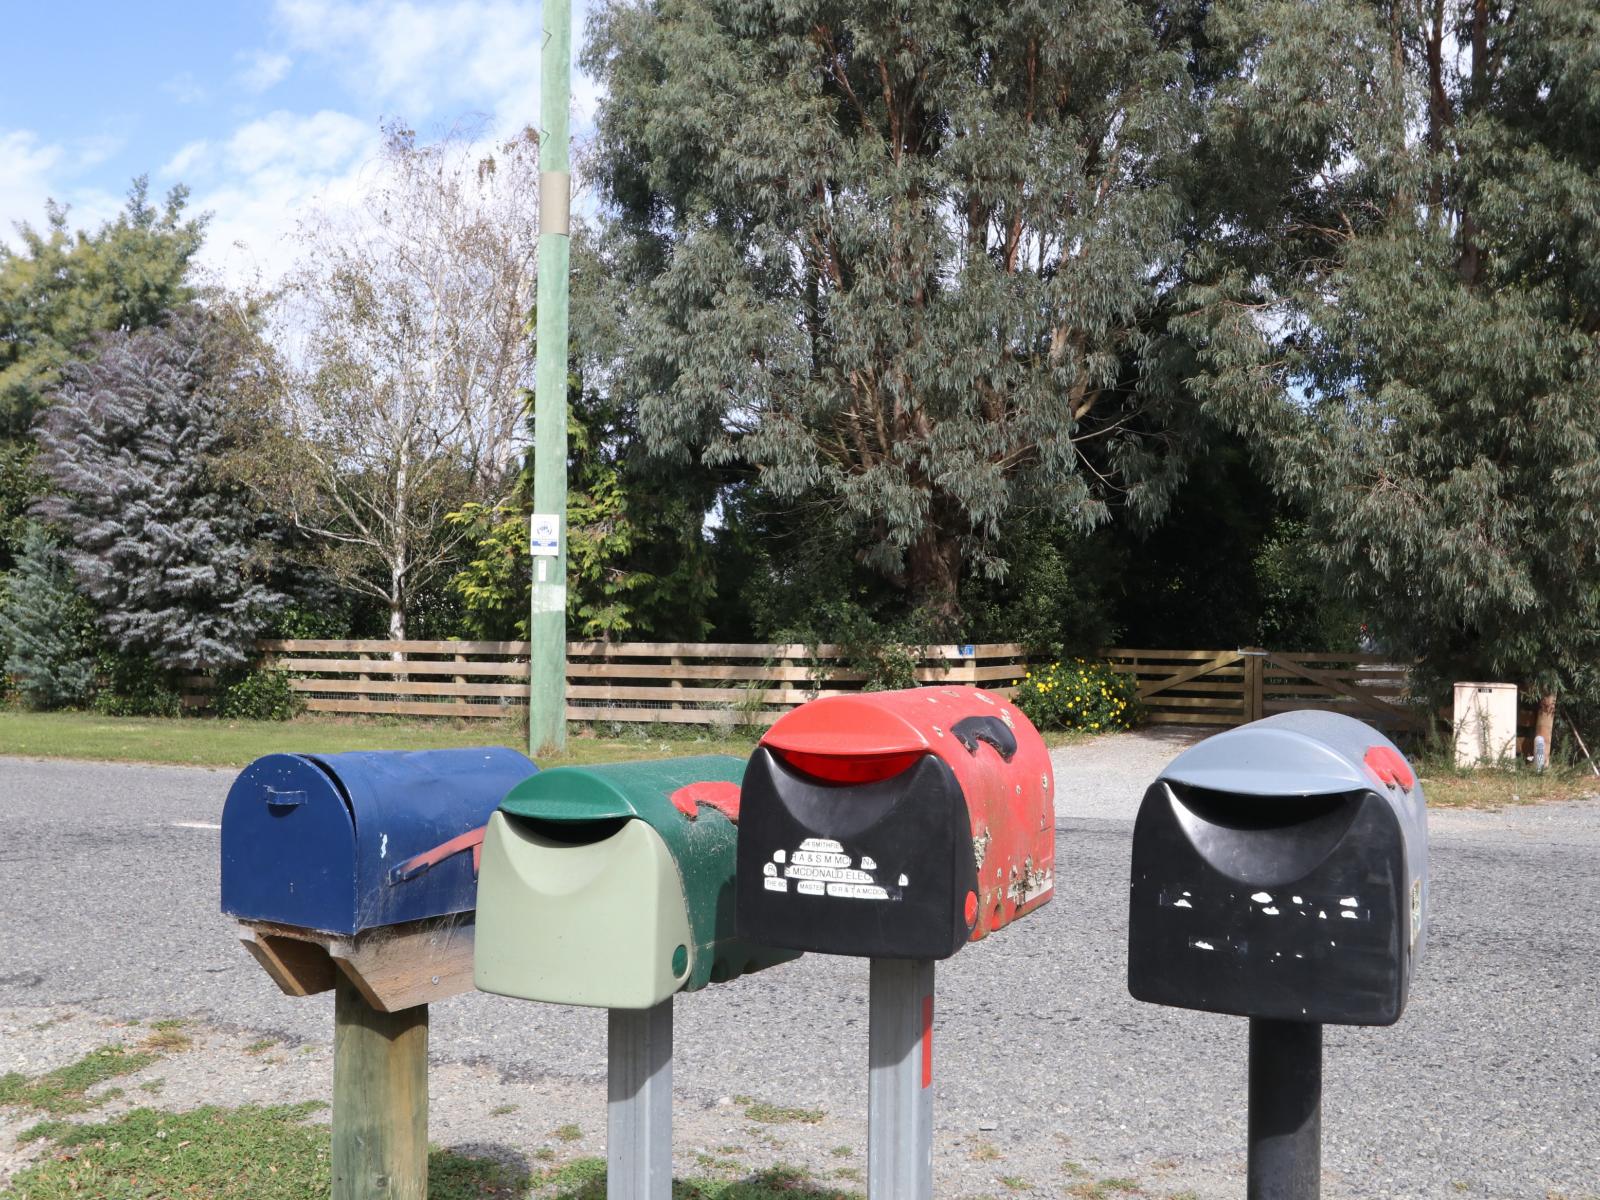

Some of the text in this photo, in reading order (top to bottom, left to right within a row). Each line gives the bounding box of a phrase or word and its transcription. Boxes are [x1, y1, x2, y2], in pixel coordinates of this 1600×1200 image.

[799, 853, 805, 861] A
[807, 853, 813, 863] &
[815, 854, 822, 863] S
[824, 855, 832, 864] M
